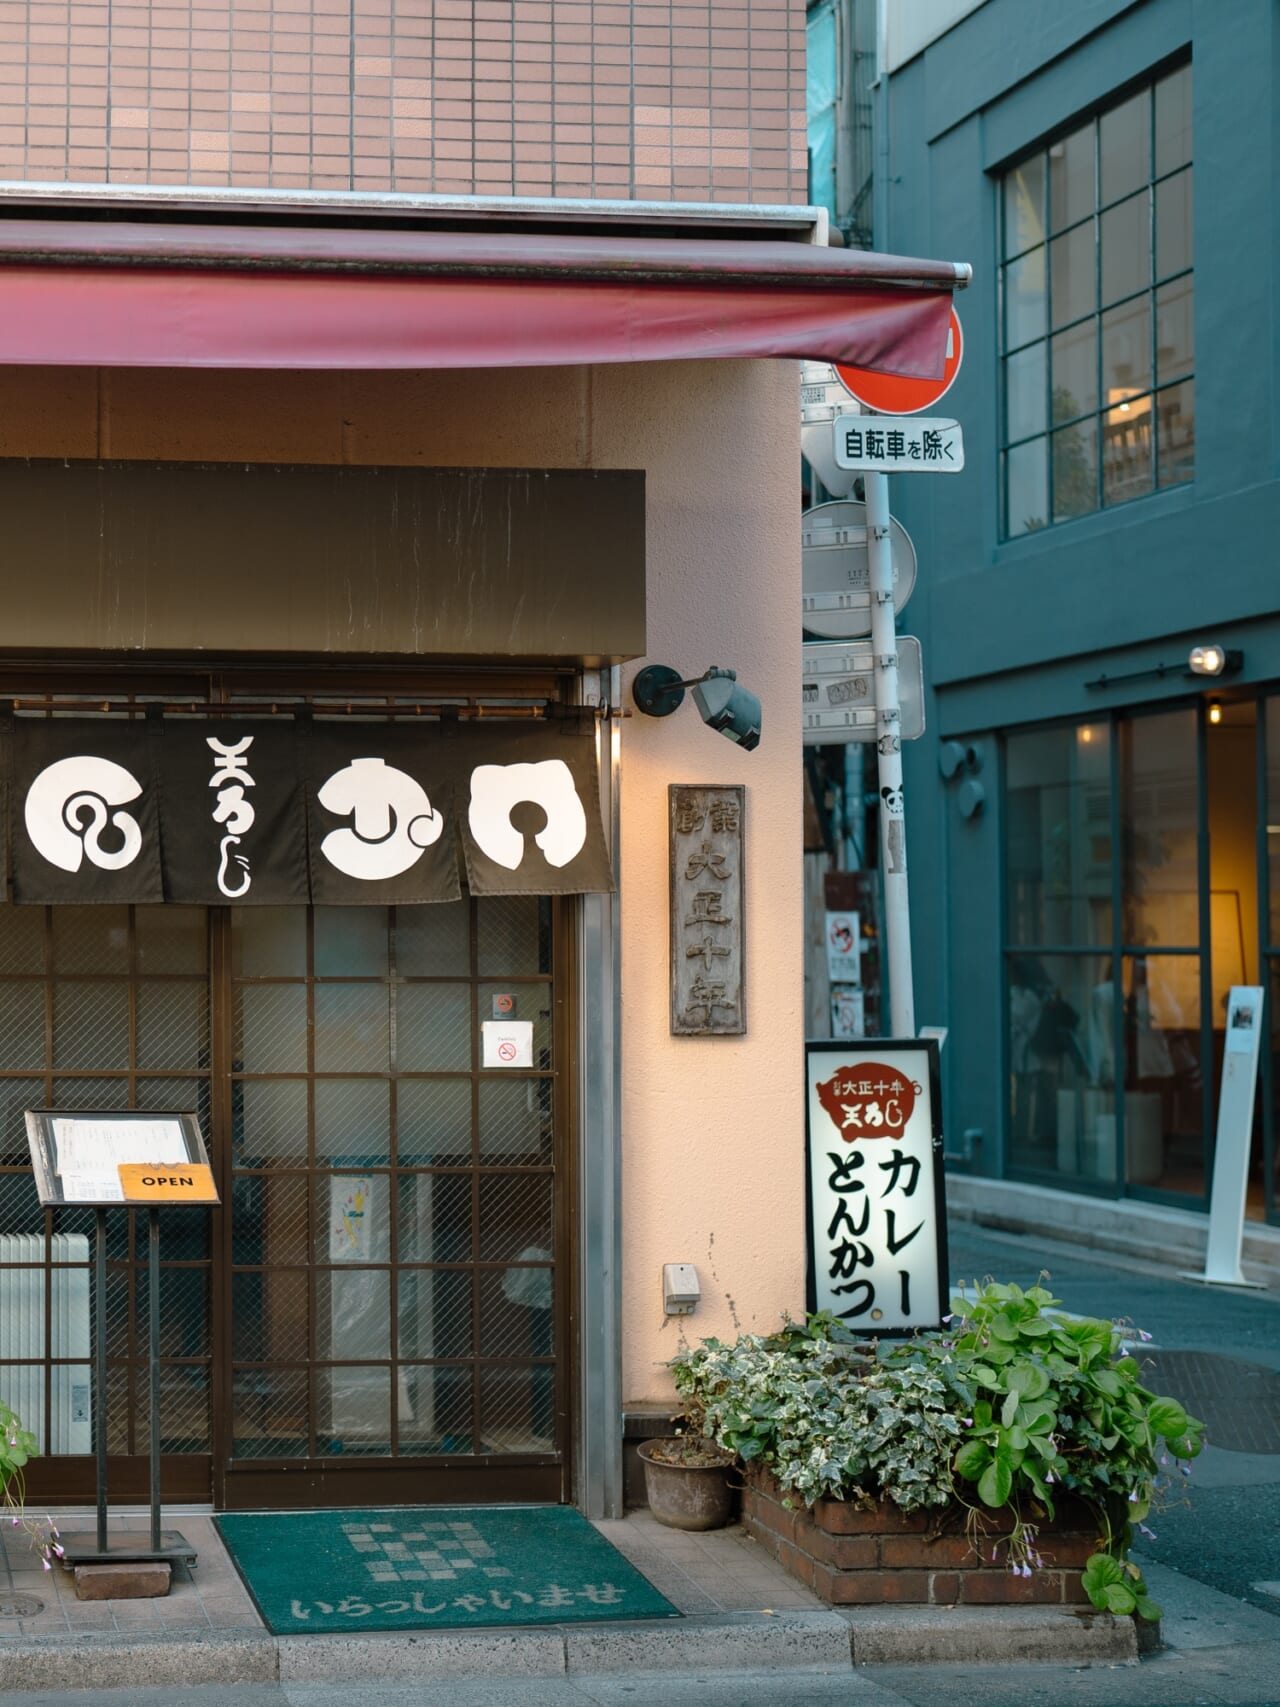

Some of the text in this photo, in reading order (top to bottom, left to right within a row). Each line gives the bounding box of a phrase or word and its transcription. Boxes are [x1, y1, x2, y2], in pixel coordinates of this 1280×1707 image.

[846, 429, 954, 460] 自転車を除く
[685, 840, 735, 1027] 大正十年
[842, 1079, 904, 1097] 大正十年
[142, 1177, 194, 1187] OPEN
[826, 1150, 876, 1319] とんかつ
[878, 1149, 925, 1316] カレー
[291, 1583, 626, 1619] いらっしゃいませ
